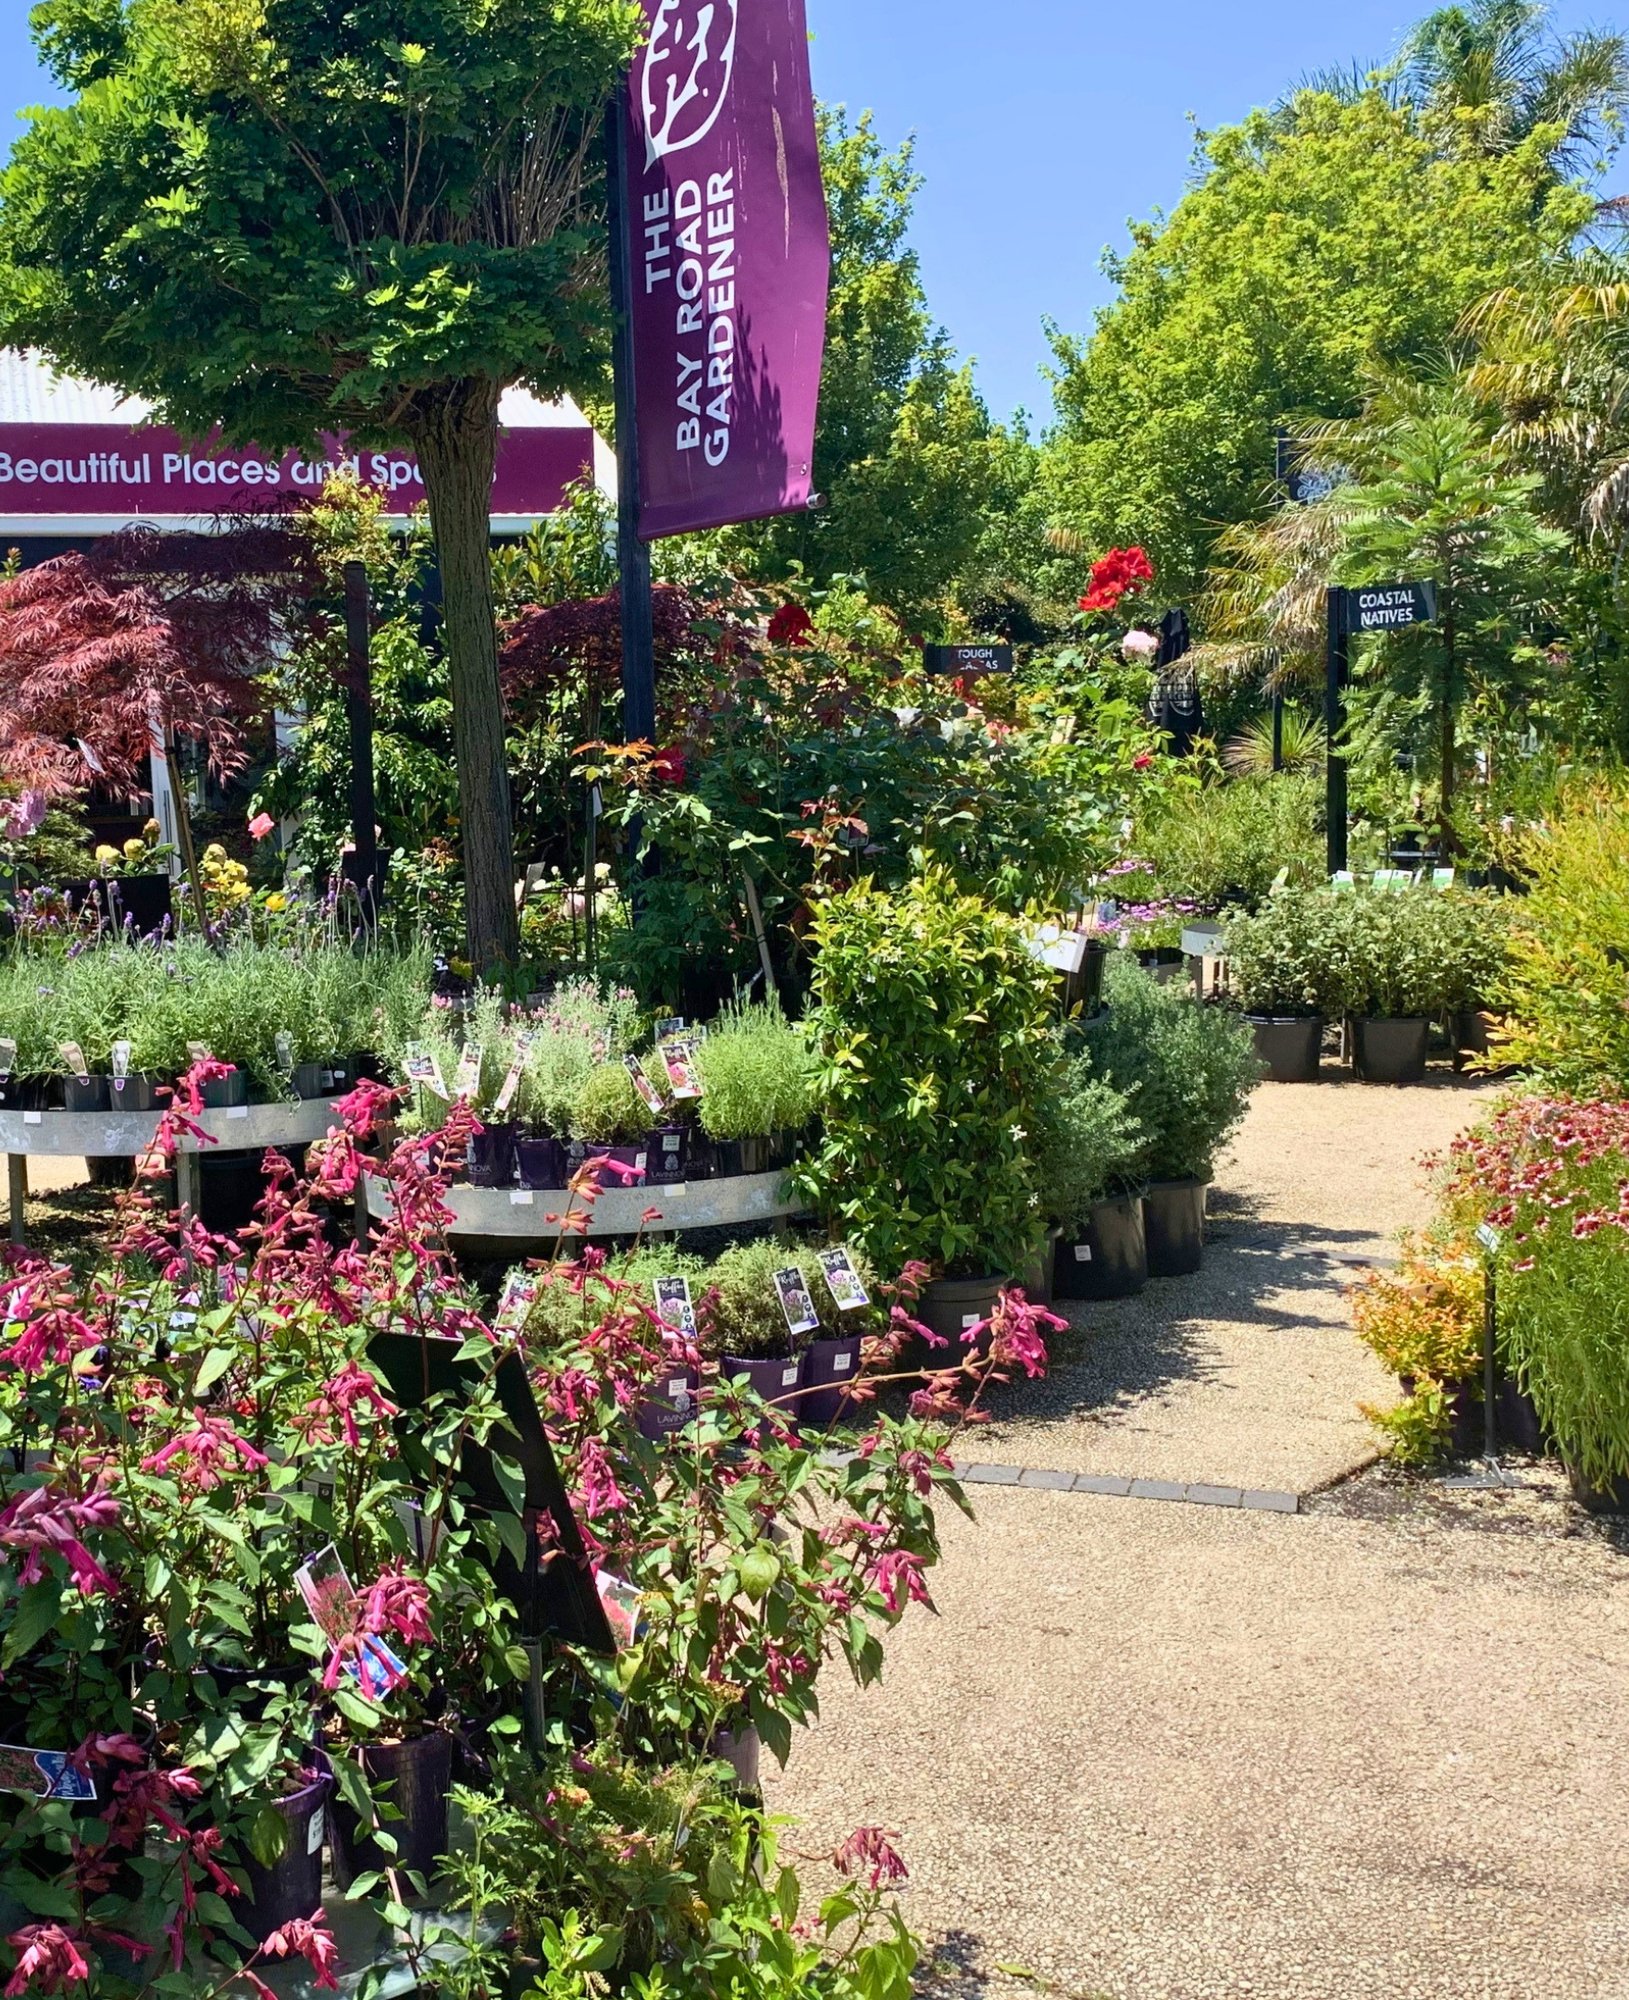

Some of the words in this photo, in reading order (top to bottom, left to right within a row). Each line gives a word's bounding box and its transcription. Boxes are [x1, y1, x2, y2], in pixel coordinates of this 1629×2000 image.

[643, 187, 671, 294] THE
[674, 179, 703, 335] ROAD
[704, 167, 735, 468] GARDENER
[676, 351, 703, 451] BAY
[0, 452, 151, 484] Beautiful
[163, 453, 281, 485] Places
[290, 455, 360, 485] and
[1359, 590, 1415, 609] COASTAL
[1361, 607, 1413, 626] NATIVES
[958, 648, 993, 659] TOUGH
